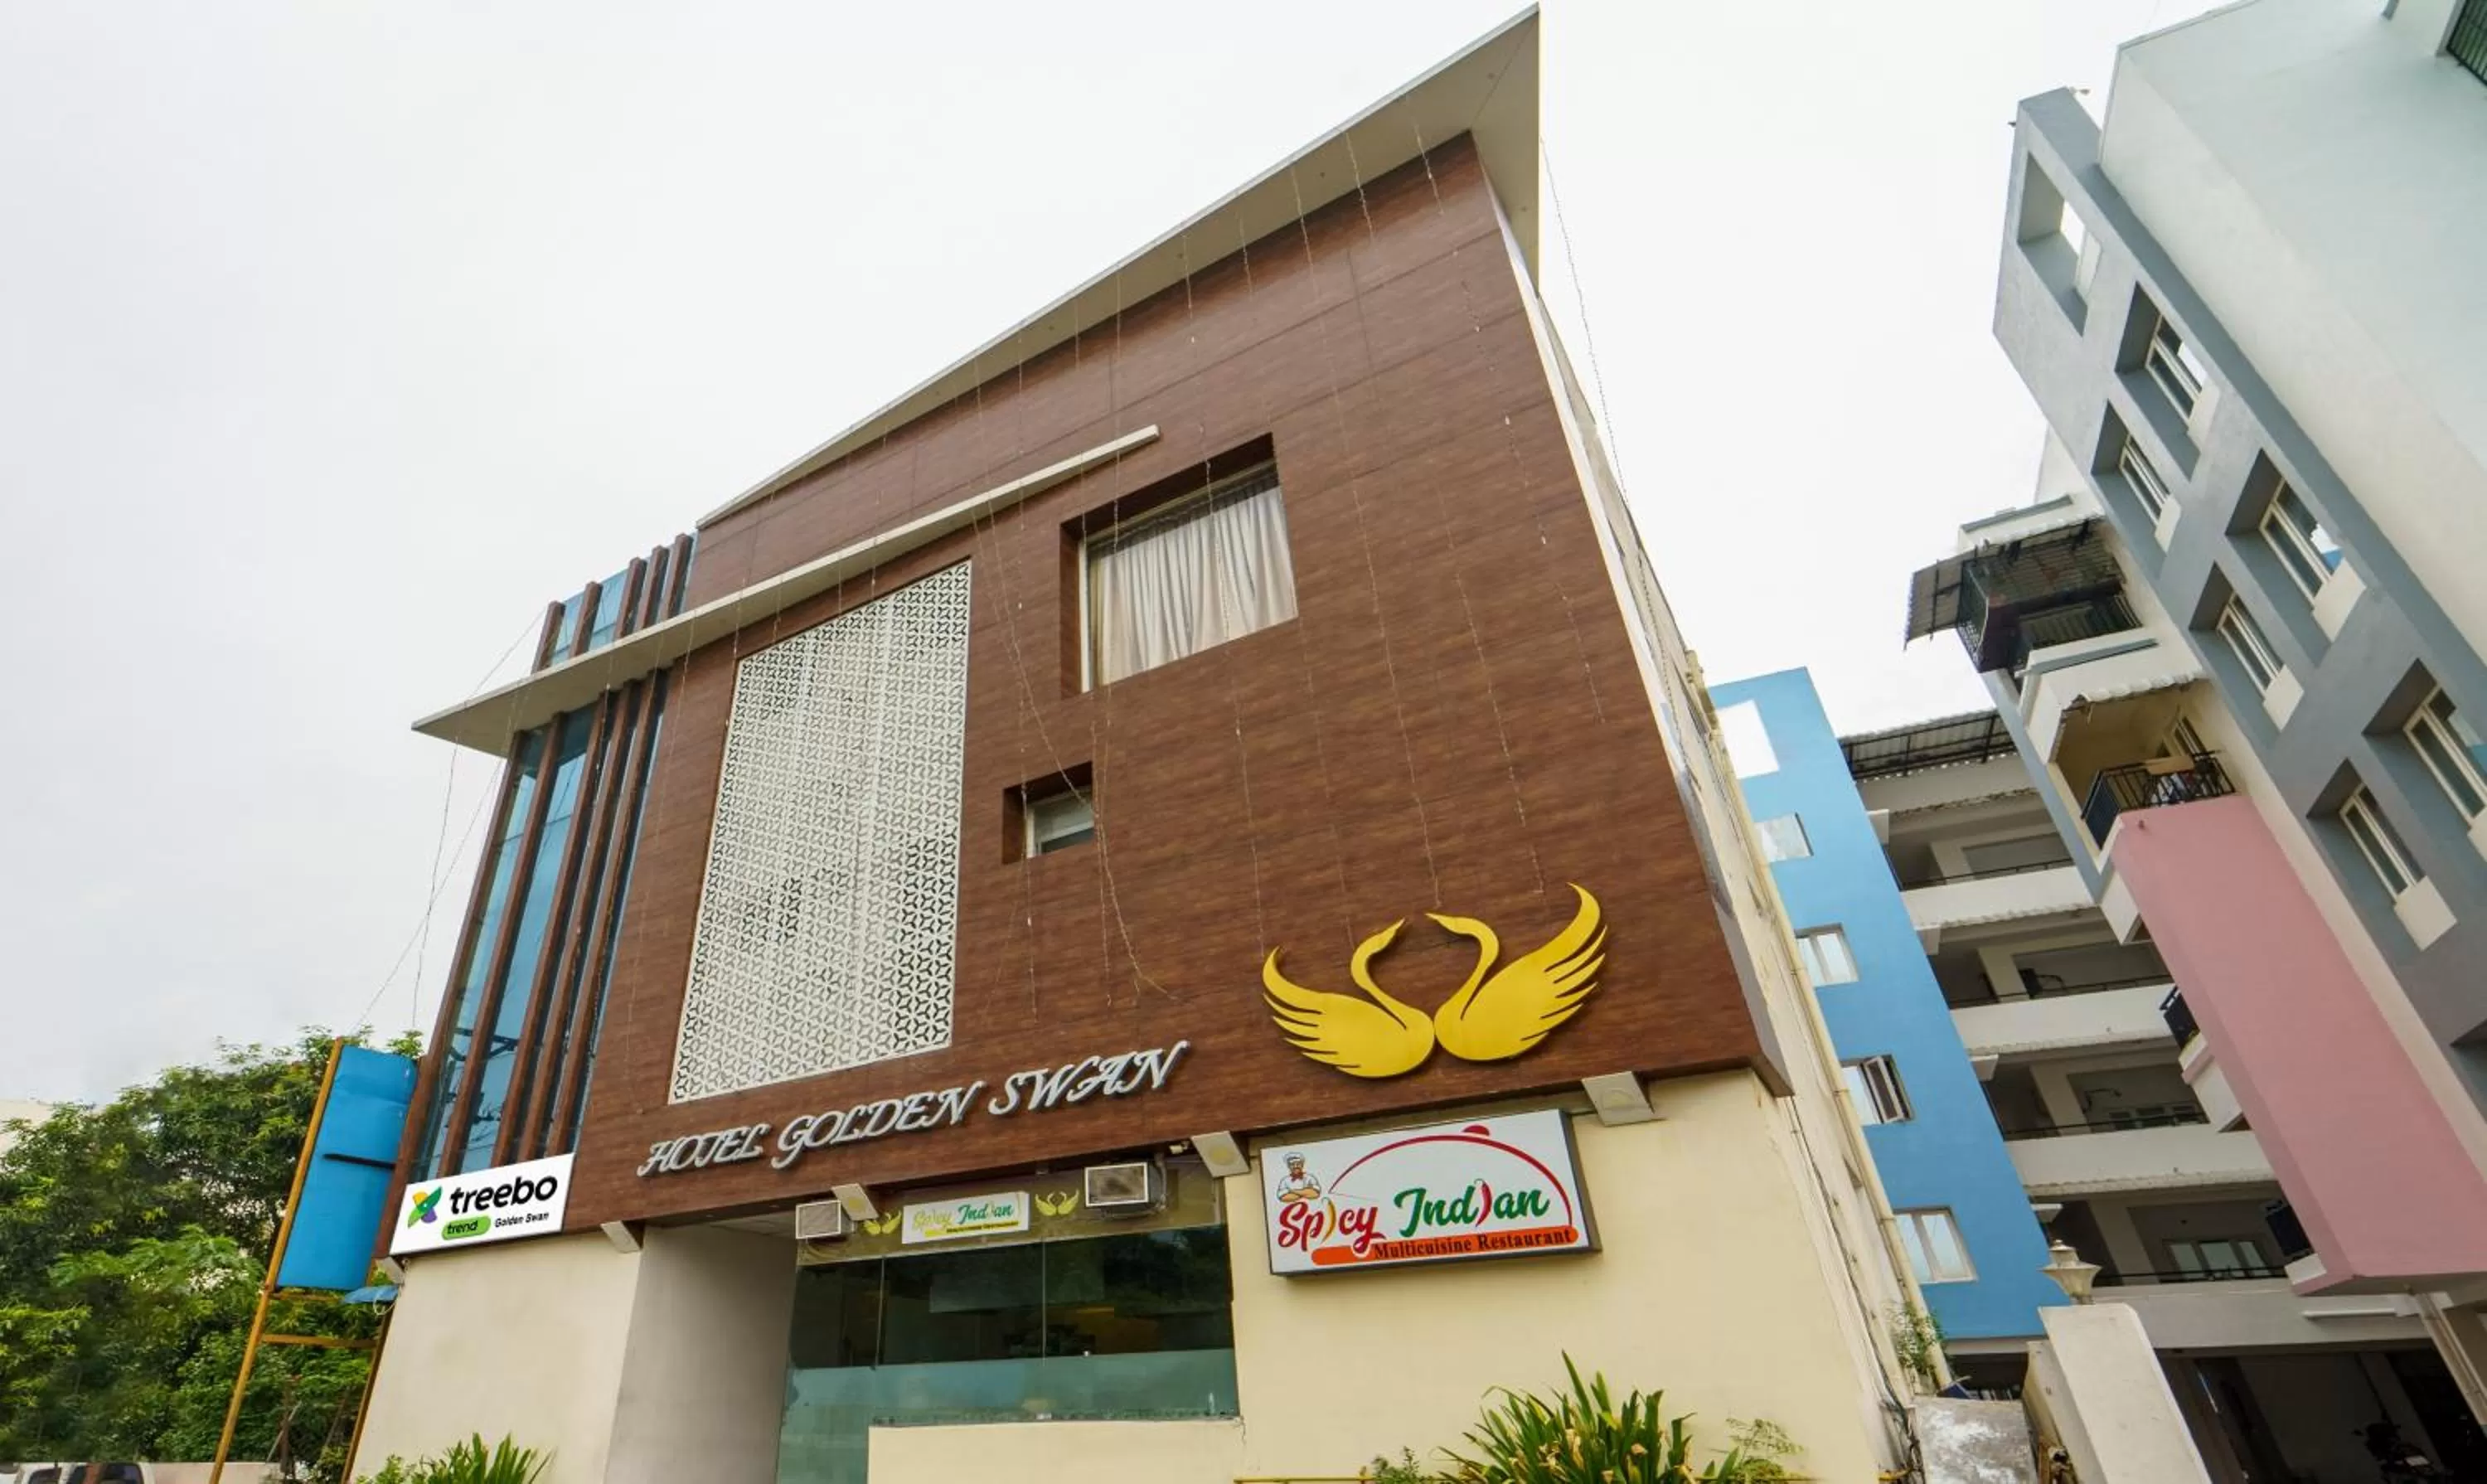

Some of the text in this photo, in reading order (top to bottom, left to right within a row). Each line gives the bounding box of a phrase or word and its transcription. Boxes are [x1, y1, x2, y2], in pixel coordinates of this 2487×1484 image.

[637, 1040, 1189, 1177] HOTEL GOLDEN SWAN
[449, 1176, 558, 1215] treebo
[446, 1220, 479, 1235] trend
[494, 1212, 549, 1228] Golden Swan
[1277, 1178, 1550, 1254] Spicy Indian
[1374, 1229, 1573, 1259] Multicuisine Restaurant
